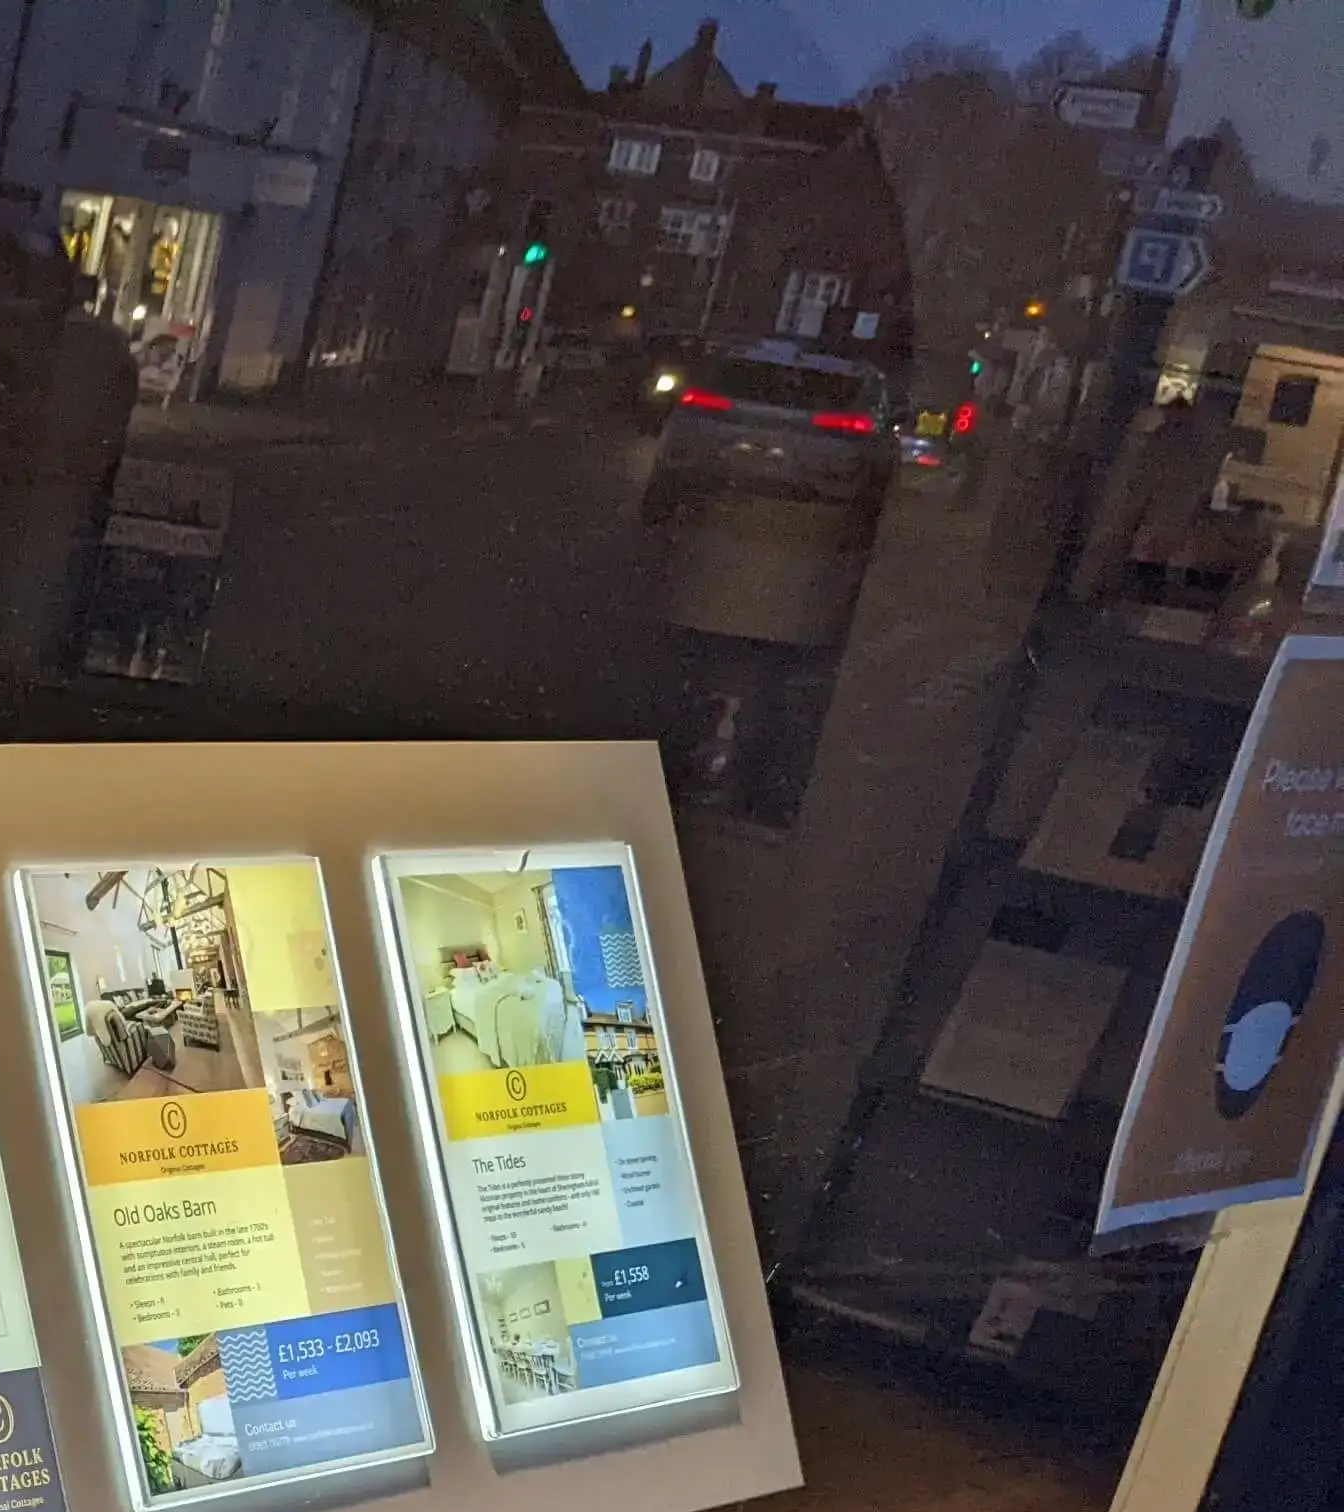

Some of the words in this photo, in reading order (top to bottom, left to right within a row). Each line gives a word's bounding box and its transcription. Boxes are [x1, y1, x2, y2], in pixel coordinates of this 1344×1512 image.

[474, 1107, 518, 1121] NORFOLK
[519, 1101, 567, 1117] COTTAGES
[118, 1146, 176, 1165] NORFOLK
[178, 1140, 238, 1158] COTTAGES
[471, 1158, 494, 1174] The
[494, 1153, 526, 1170] Tides
[113, 1205, 140, 1227] Old
[142, 1201, 180, 1222] Oaks
[181, 1199, 216, 1218] Barn
[613, 1265, 649, 1285] £1,558
[277, 1338, 324, 1363] £1,533
[335, 1329, 380, 1353] £2,093
[282, 1368, 296, 1380] Per
[297, 1363, 319, 1377] week
